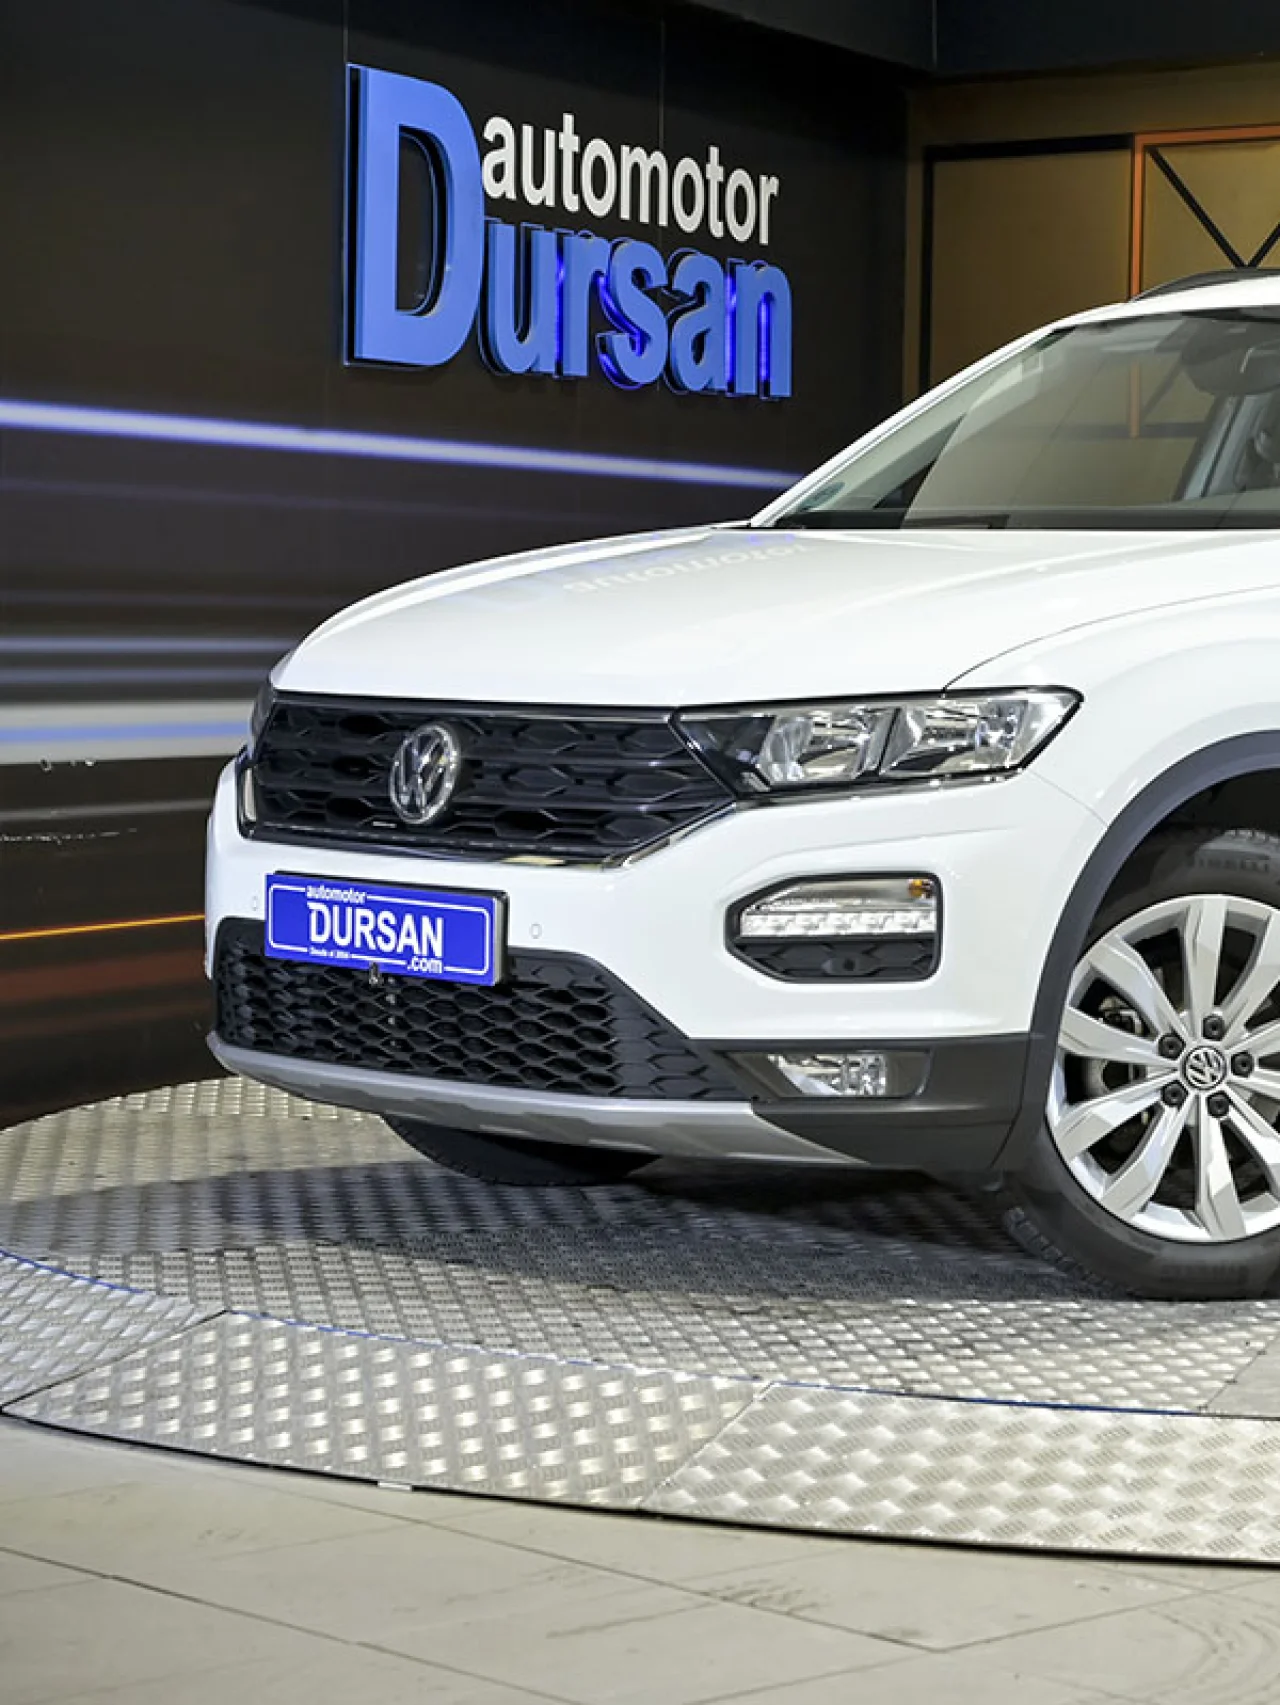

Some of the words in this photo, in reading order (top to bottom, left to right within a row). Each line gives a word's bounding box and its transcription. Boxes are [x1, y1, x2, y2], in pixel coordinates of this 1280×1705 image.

[482, 113, 779, 244] automotor
[344, 63, 793, 398] Dursan
[306, 885, 367, 904] automotor
[307, 902, 443, 958] DURSAN
[407, 955, 443, 974] .com
